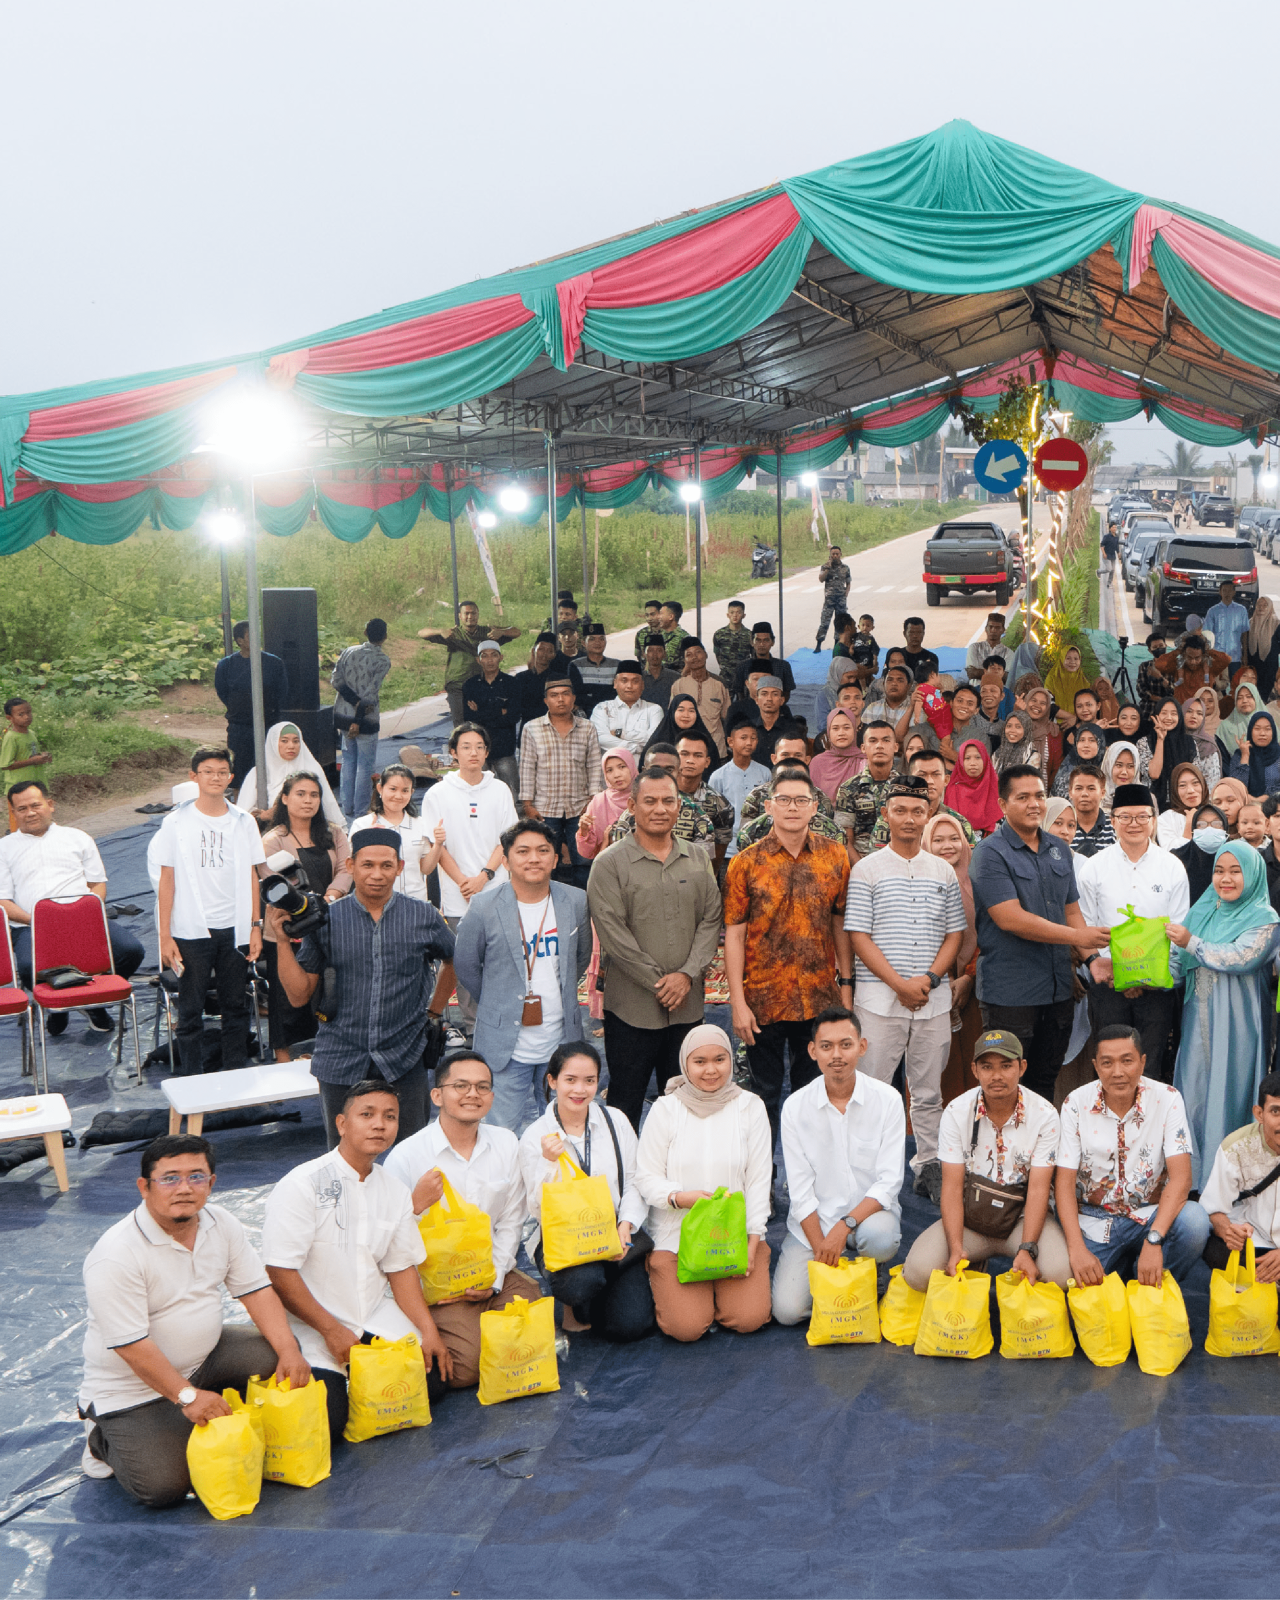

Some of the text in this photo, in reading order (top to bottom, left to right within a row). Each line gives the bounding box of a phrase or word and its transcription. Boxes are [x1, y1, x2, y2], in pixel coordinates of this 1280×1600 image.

[200, 830, 224, 849] ADI
[200, 849, 224, 868] DAS
[850, 1331, 865, 1339] BTN
